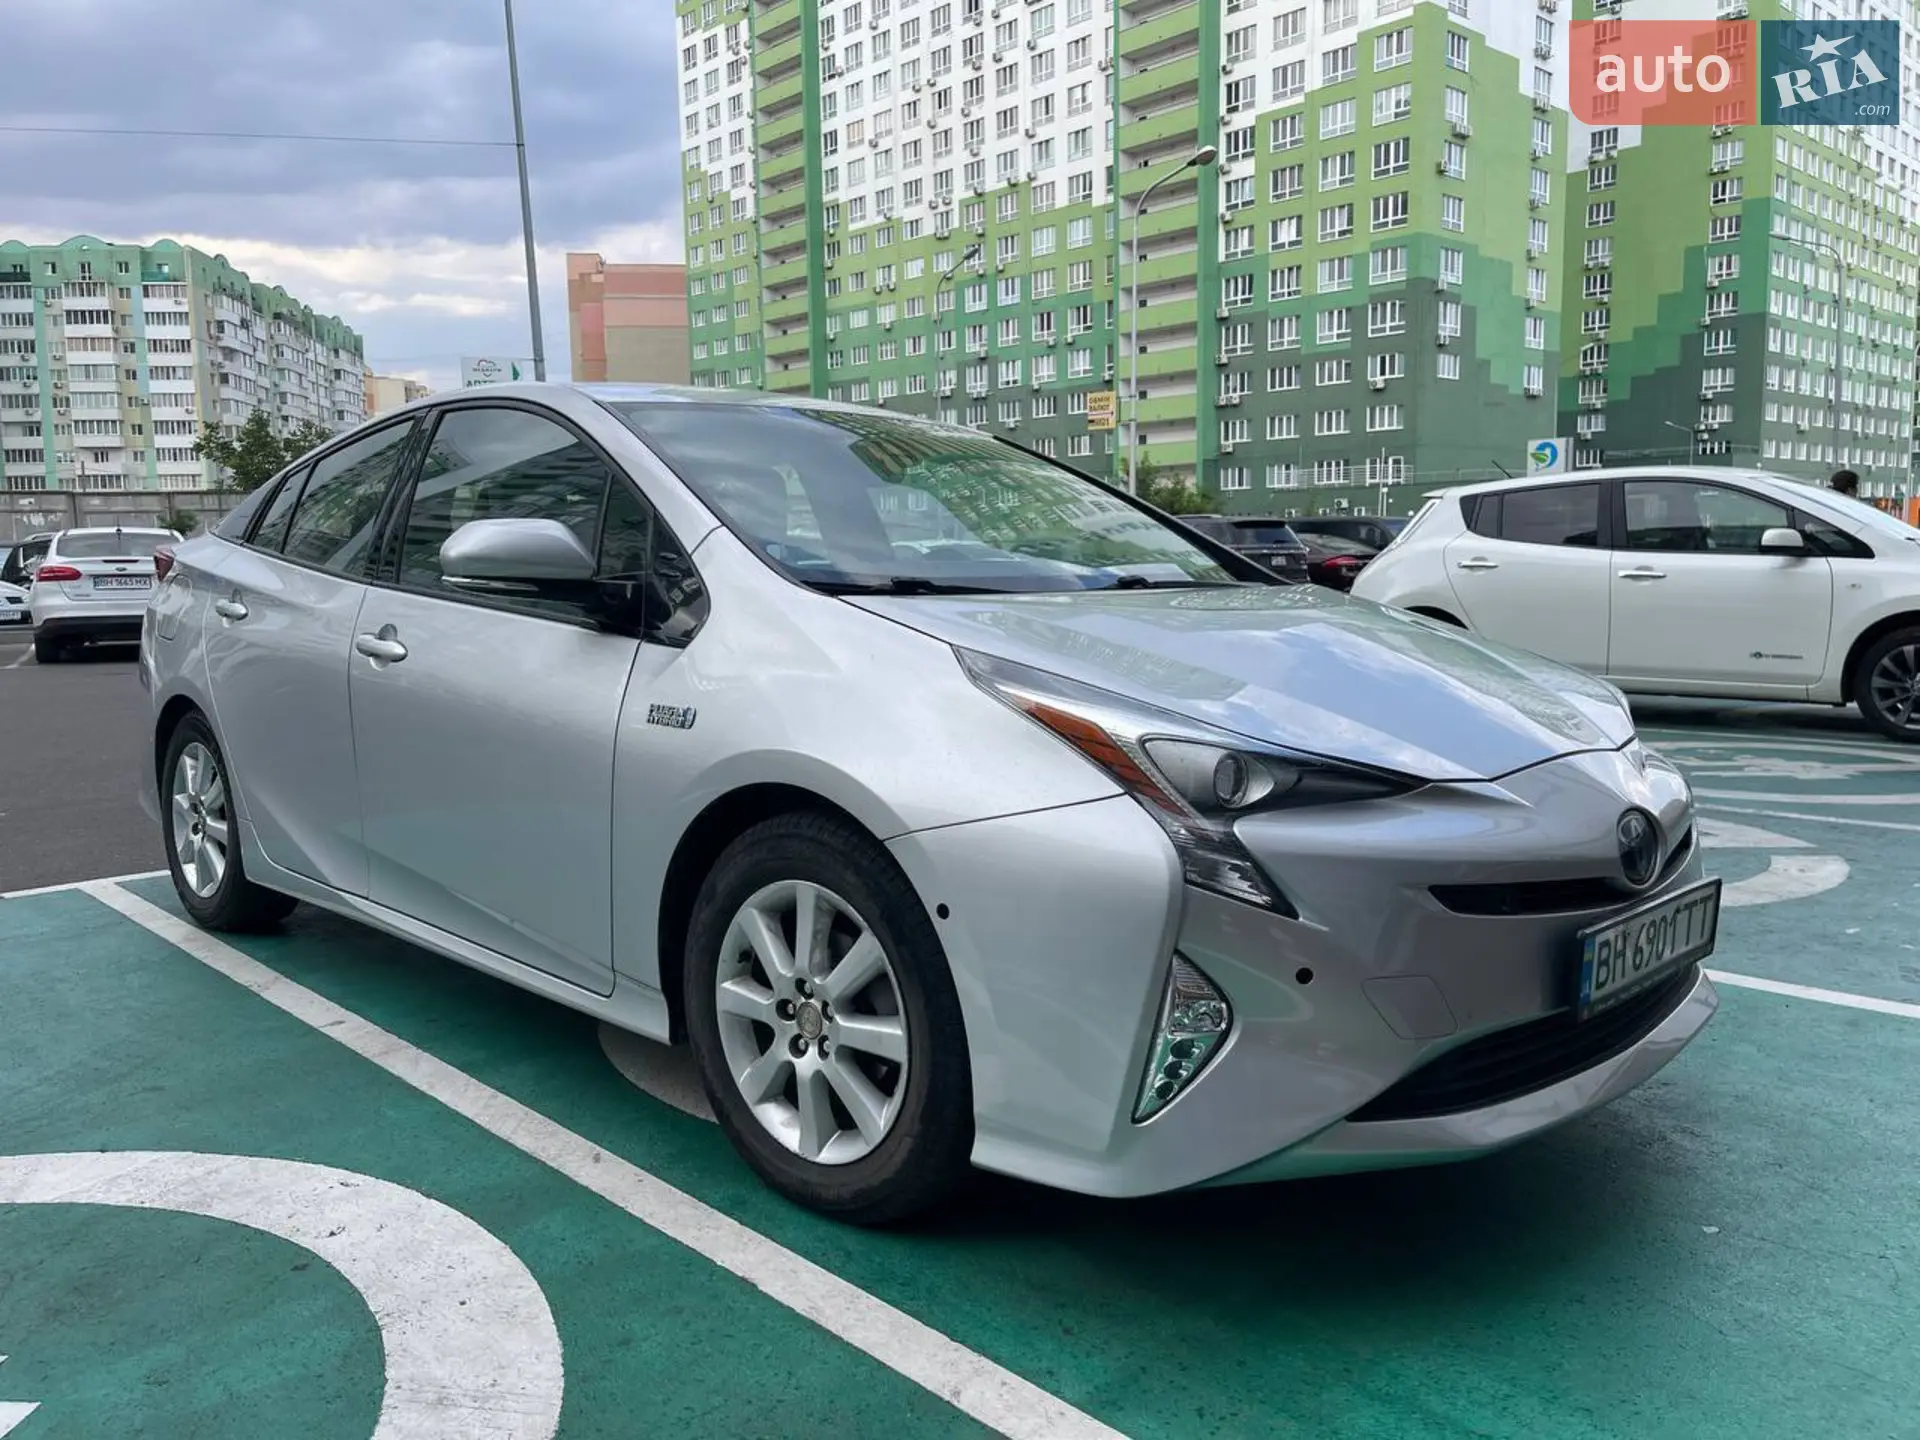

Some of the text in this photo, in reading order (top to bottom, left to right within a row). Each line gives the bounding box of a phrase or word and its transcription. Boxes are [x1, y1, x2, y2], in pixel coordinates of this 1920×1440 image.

[1595, 929, 1627, 990] BH
[1633, 907, 1682, 972] 6901
[1681, 894, 1715, 947] TT
